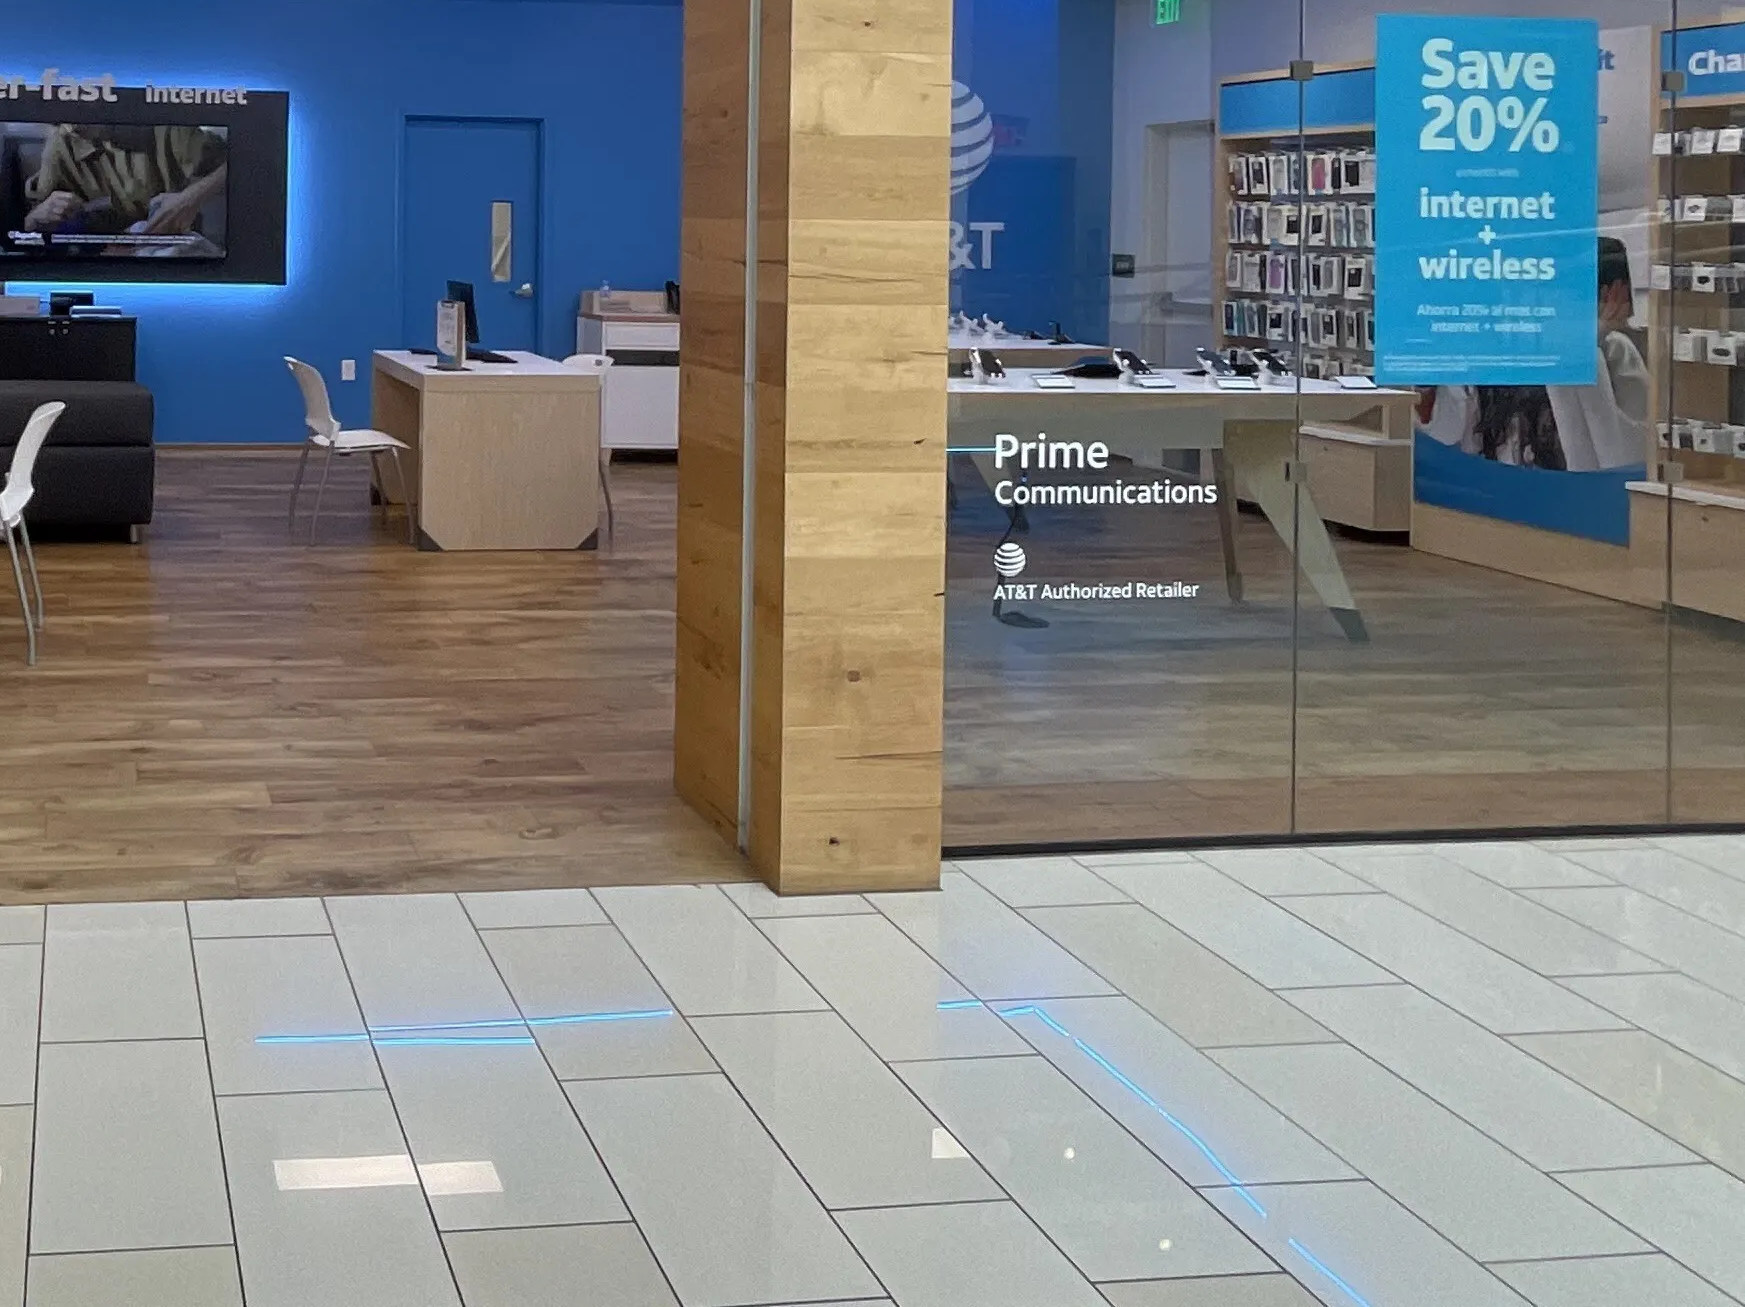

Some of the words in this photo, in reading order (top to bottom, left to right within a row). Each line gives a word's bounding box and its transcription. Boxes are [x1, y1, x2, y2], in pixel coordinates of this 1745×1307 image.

[1420, 37, 1555, 91] Save
[1688, 49, 1745, 76] Cha
[146, 83, 248, 105] internet
[1418, 95, 1560, 153] 20%
[1419, 186, 1556, 220] internet
[1418, 249, 1556, 281] wireless
[994, 432, 1109, 469] Prime
[994, 479, 1218, 507] Communications
[993, 584, 1037, 601] AT&T
[1040, 582, 1133, 600] Authorized
[1136, 581, 1199, 598] Retailer
